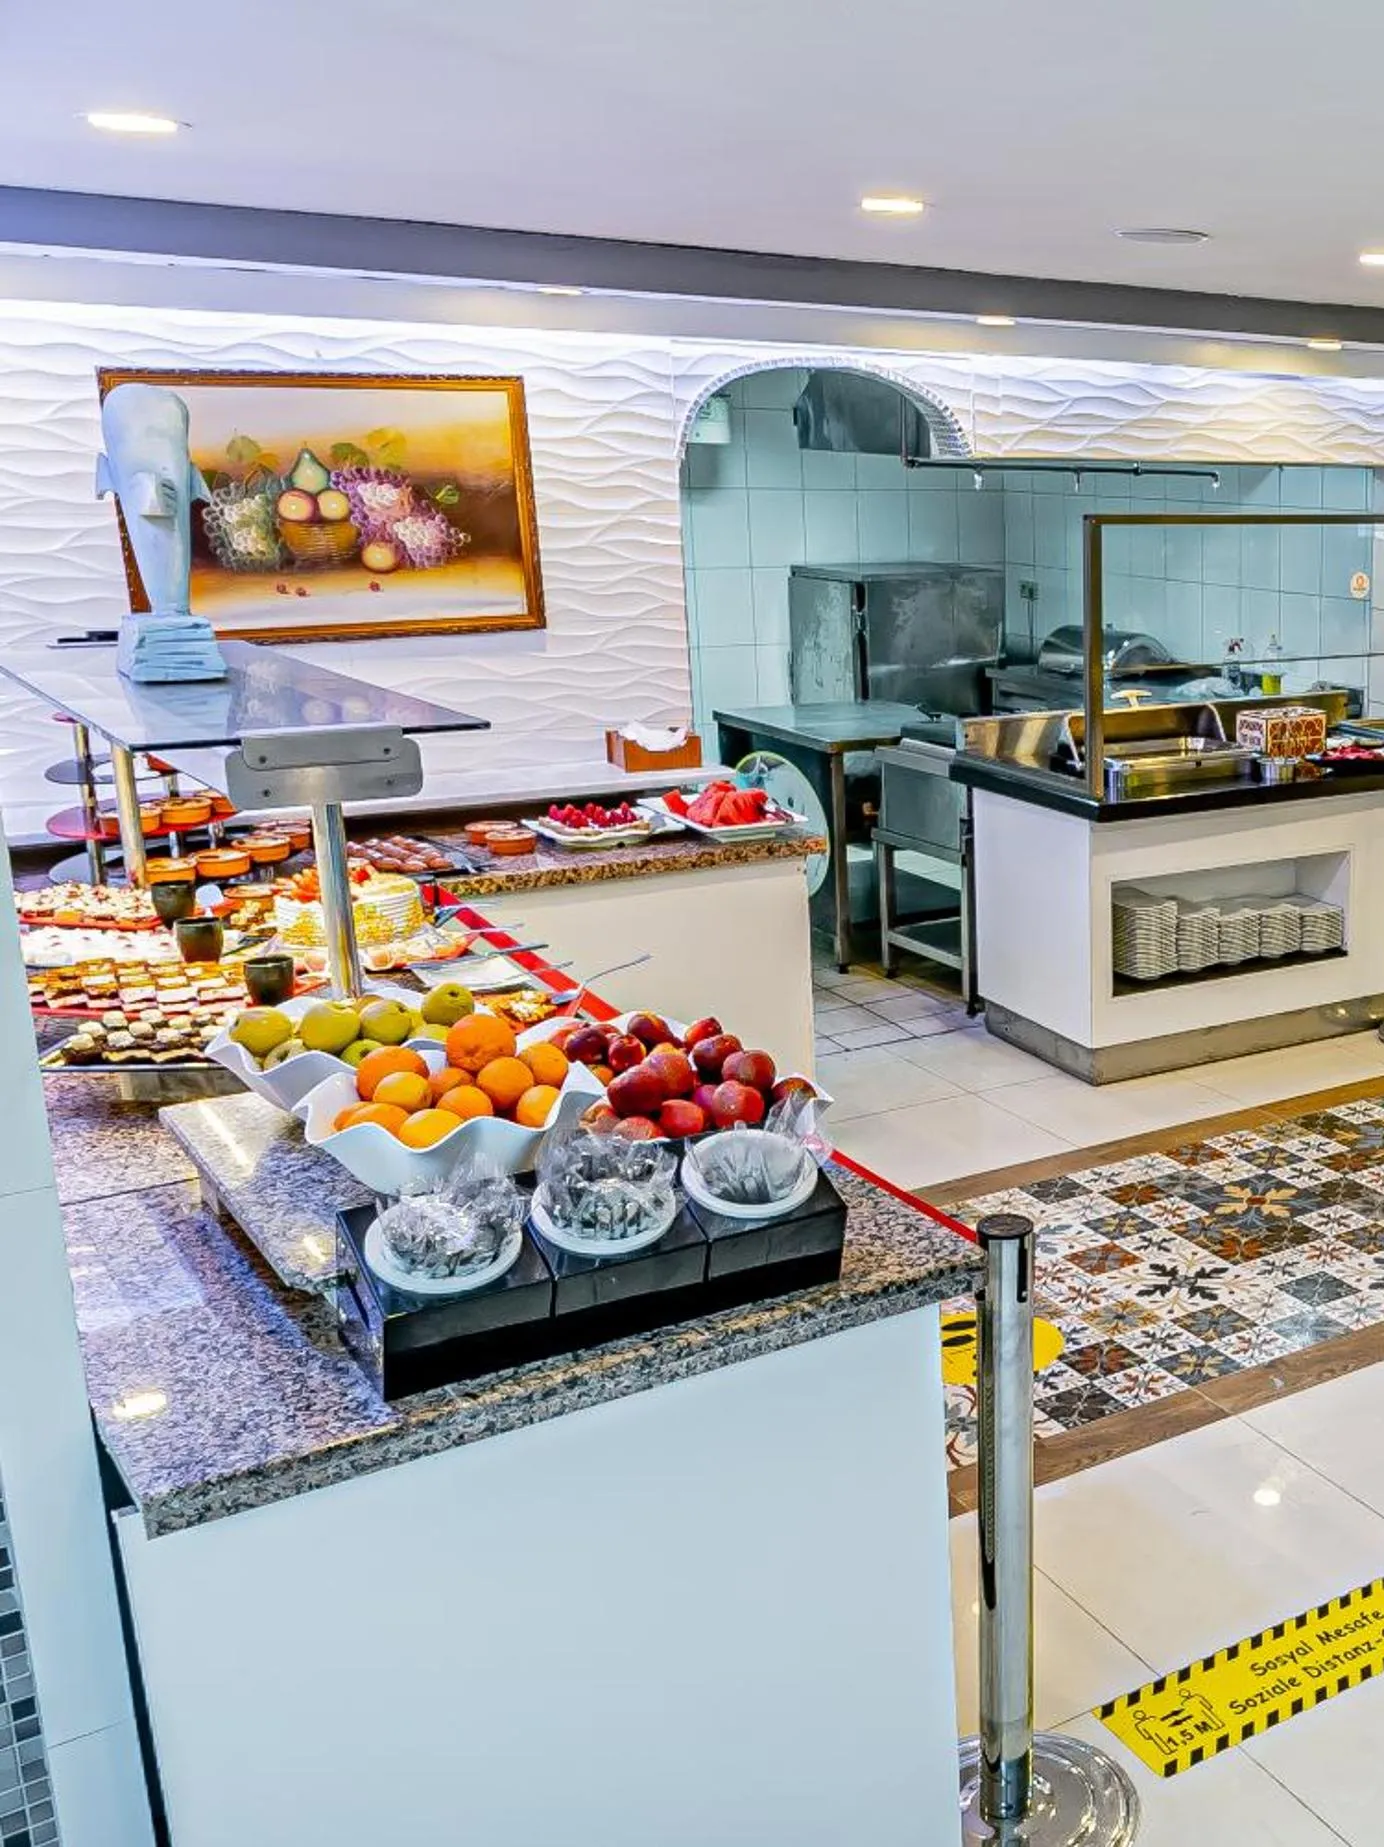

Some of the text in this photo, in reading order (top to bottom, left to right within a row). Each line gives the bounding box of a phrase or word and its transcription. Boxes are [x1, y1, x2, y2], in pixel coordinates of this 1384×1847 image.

[1250, 1640, 1314, 1676] Sosyal
[1229, 1678, 1302, 1715] Soziale
[1167, 1721, 1213, 1747] 1,5 M
